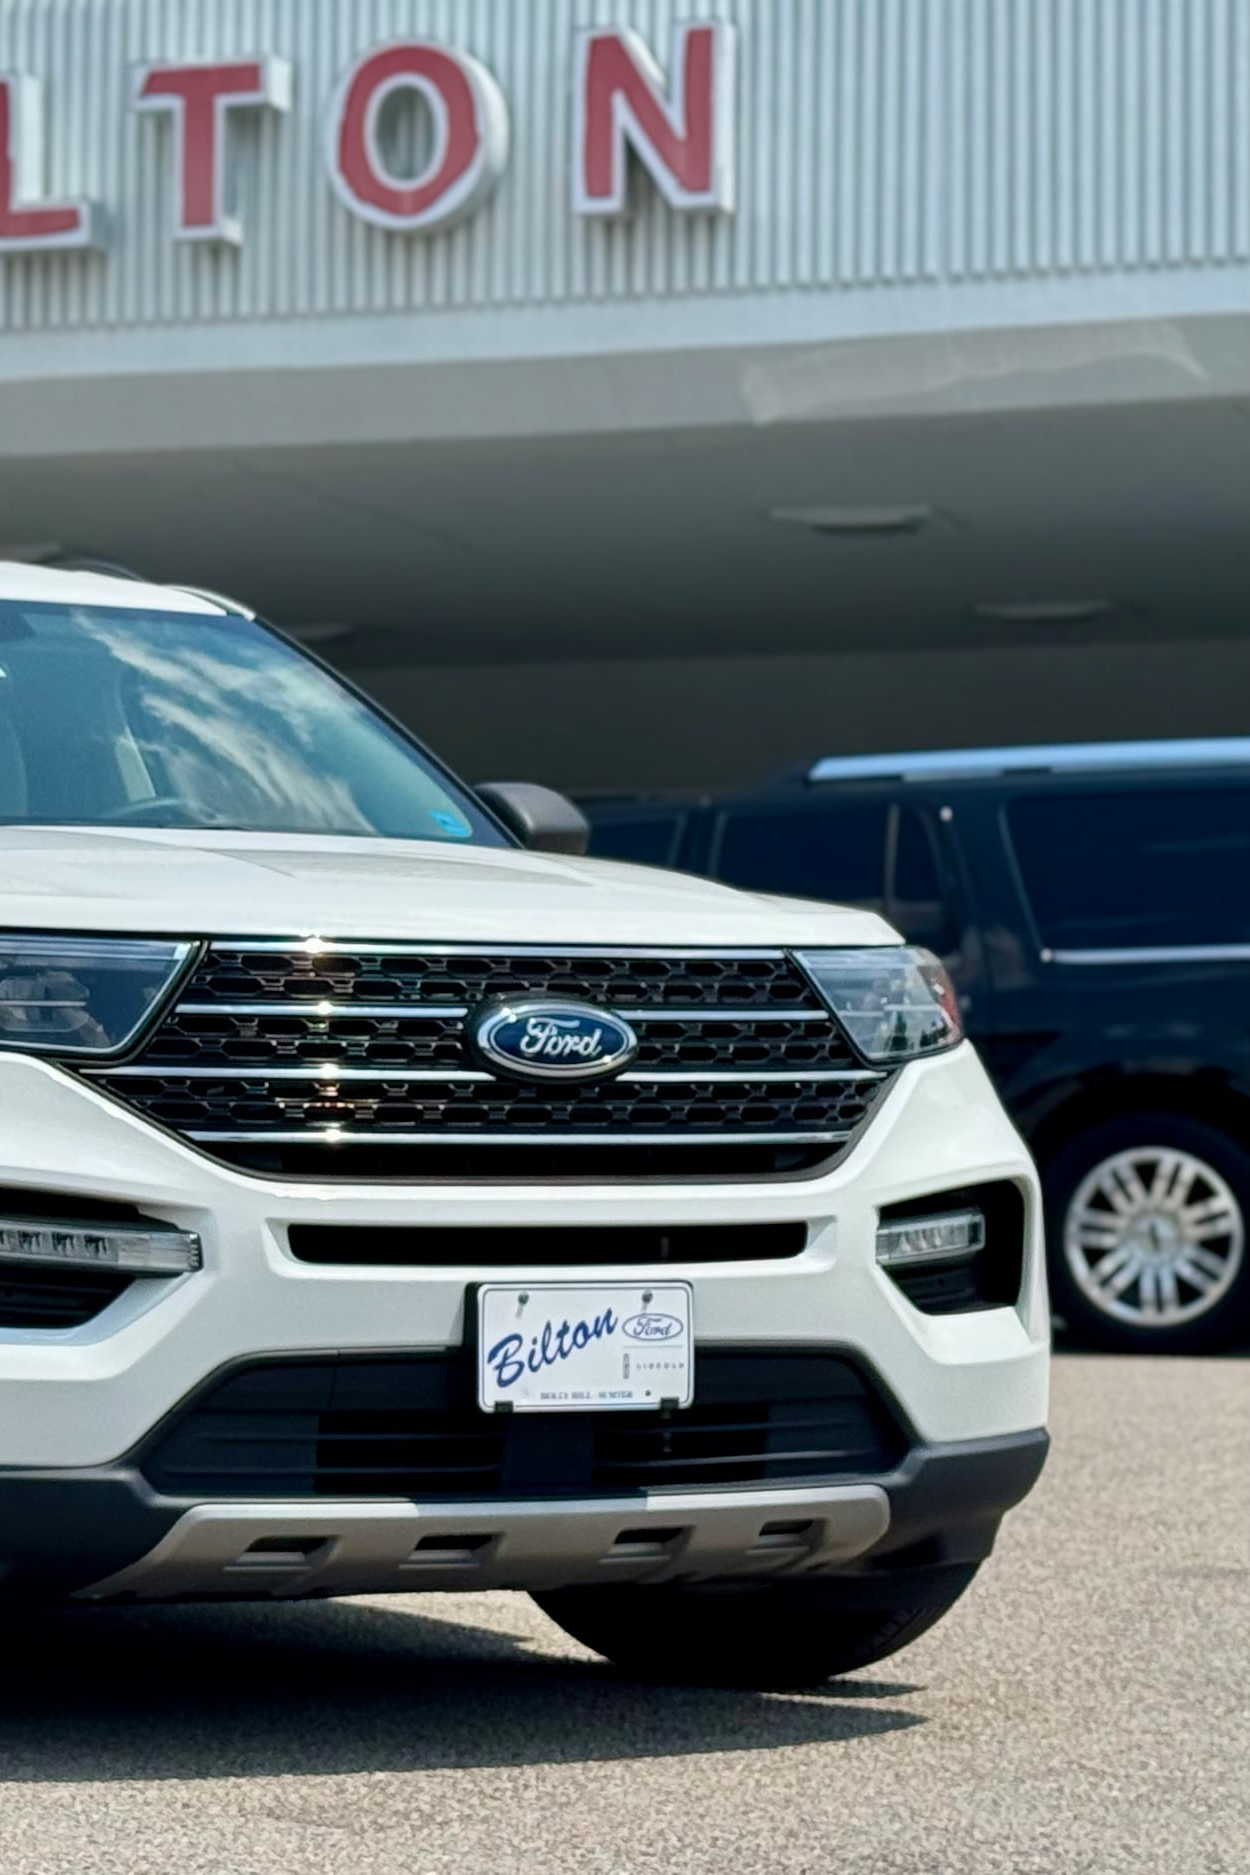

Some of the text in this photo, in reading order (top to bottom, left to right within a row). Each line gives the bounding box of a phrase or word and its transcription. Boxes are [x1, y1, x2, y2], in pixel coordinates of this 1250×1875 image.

[519, 1016, 603, 1057] Ford
[632, 1314, 672, 1337] Ford
[487, 1307, 619, 1389] Bilton
